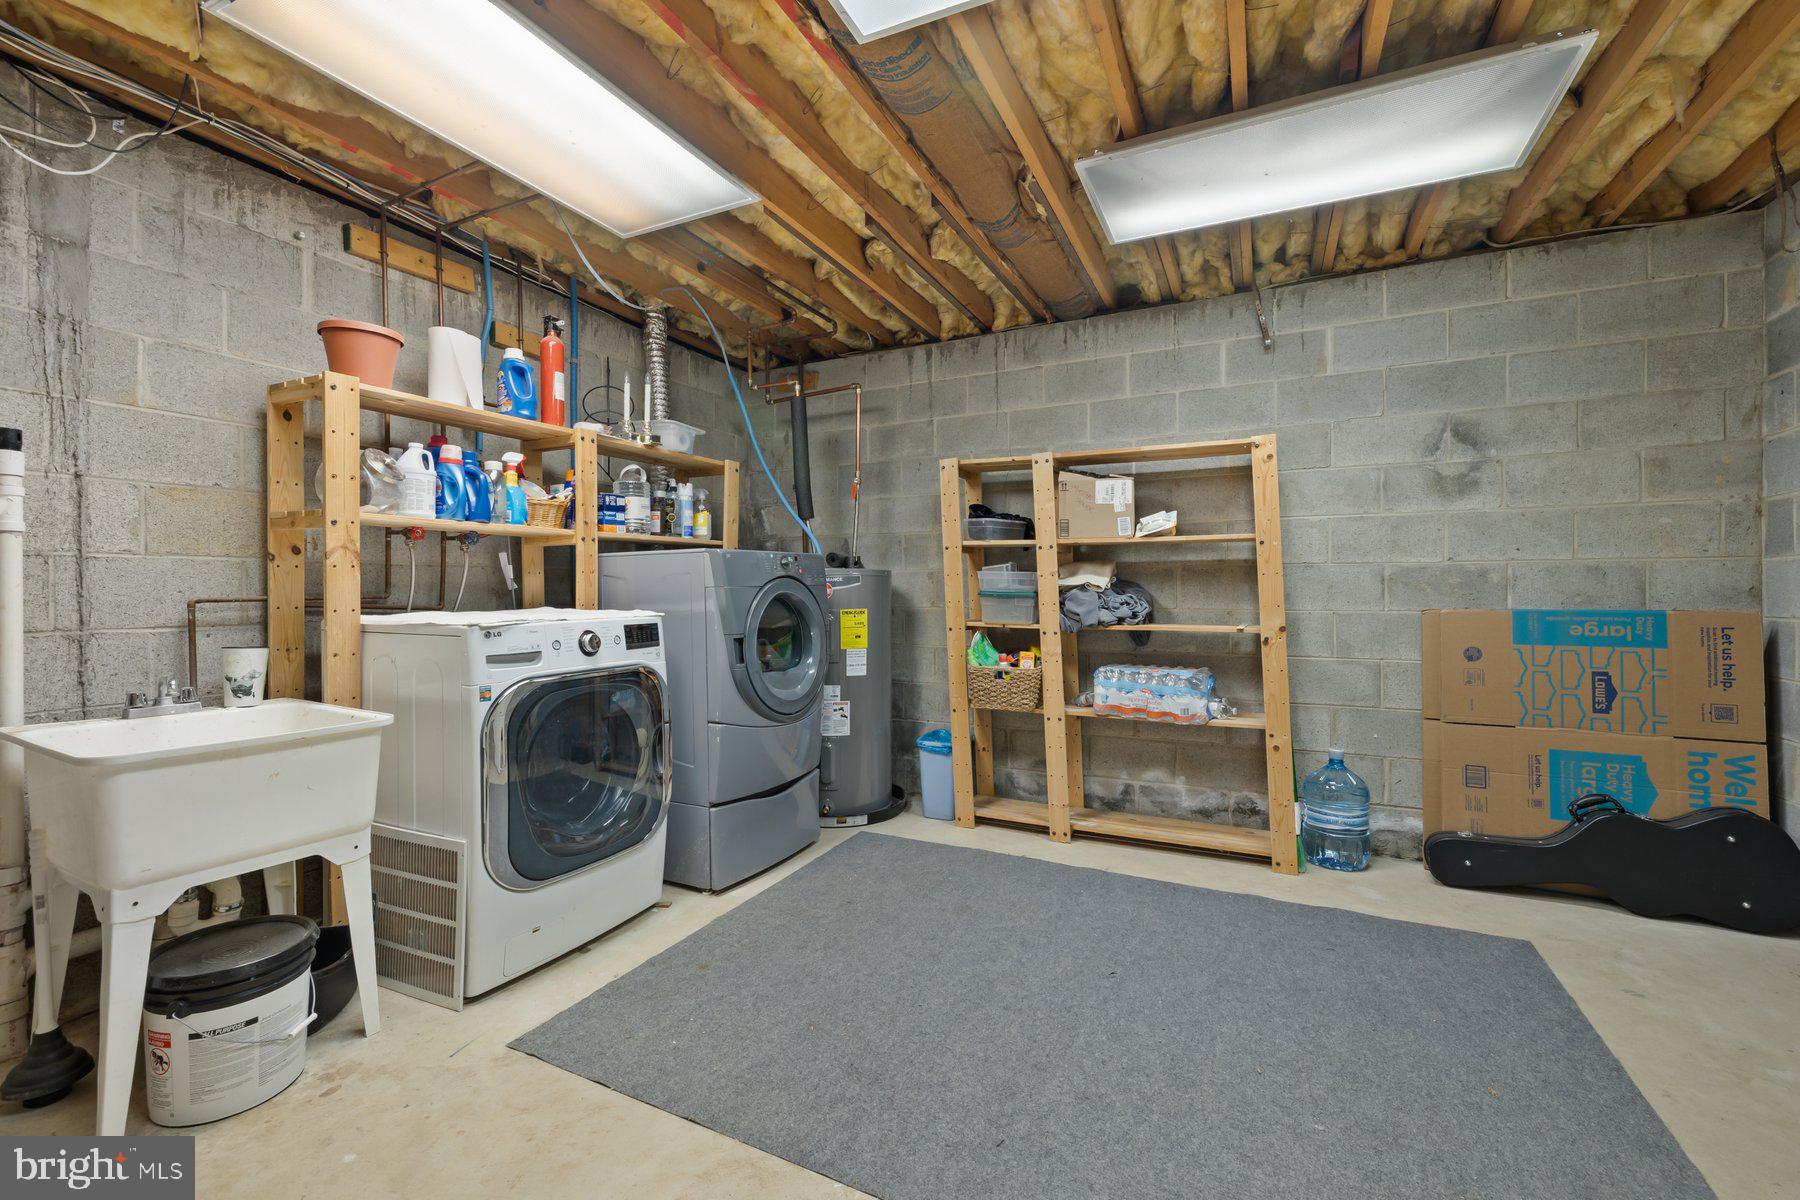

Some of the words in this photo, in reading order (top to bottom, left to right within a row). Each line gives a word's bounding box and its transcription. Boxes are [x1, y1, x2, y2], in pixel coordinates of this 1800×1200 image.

[1570, 621, 1632, 642] large
[1721, 626, 1735, 646] Let
[1721, 648, 1732, 661] us
[1720, 664, 1736, 692] help.
[1595, 676, 1607, 710] LOWE'S
[1577, 761, 1601, 798] larg
[1604, 763, 1619, 792] Duty
[1620, 764, 1636, 803] Heavy
[1688, 751, 1718, 809] hom
[1724, 755, 1757, 807] Wel
[215, 1021, 246, 1037] PURPOSE
